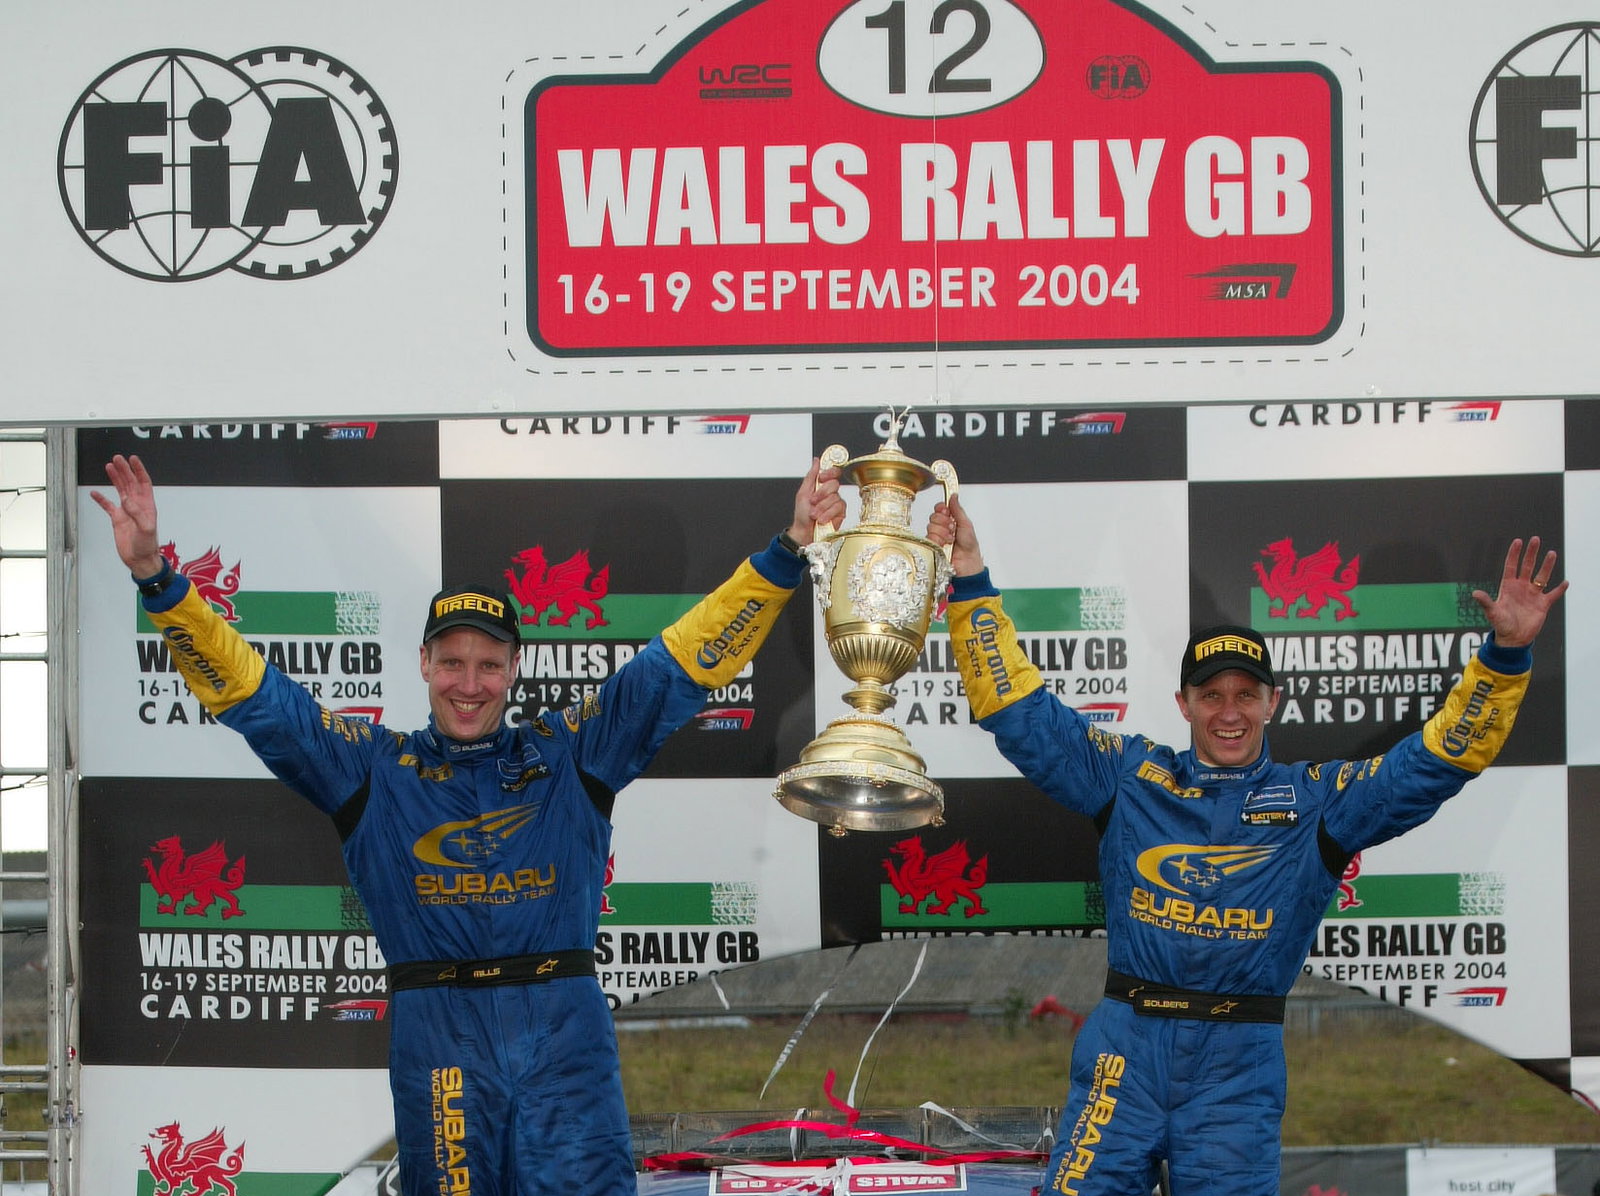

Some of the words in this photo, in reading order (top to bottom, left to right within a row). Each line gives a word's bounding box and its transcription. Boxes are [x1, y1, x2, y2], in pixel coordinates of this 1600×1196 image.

[865, 0, 992, 94] 12
[699, 63, 792, 84] WRC
[556, 142, 870, 248] WALES
[900, 138, 1166, 242] RALLY
[1184, 136, 1311, 239] GB
[557, 271, 690, 315] 16-19
[711, 267, 996, 312] SEPTEMBER
[1017, 263, 1140, 307] 2004
[1225, 282, 1269, 299] MSA
[500, 416, 681, 435] CARDIFF
[873, 411, 1057, 438] CARDIFF
[1250, 401, 1433, 427] CARDIFF
[131, 422, 310, 440] CARDIFF
[435, 593, 504, 618] PIRELLI
[697, 599, 765, 670] Corona
[729, 625, 760, 657] Extra
[1195, 634, 1263, 663] PIRELLI
[341, 641, 383, 674] GB
[966, 638, 983, 679] Extra
[970, 607, 1013, 697] Corona
[1084, 637, 1128, 671] GB
[1364, 633, 1455, 670] RALLY
[332, 681, 383, 698] 2004
[888, 680, 934, 698] 6-19
[1075, 677, 1128, 695] 2004
[1318, 673, 1443, 695] SEPTEMBER
[713, 719, 740, 730] MSA
[1281, 696, 1436, 725] ARDIFF
[1443, 679, 1496, 758] Corona
[1473, 707, 1500, 741] Extra
[414, 864, 556, 896] SUBARU
[417, 894, 468, 906] WORLD
[472, 893, 517, 905] RALLY
[523, 886, 556, 901] TEAM
[1130, 886, 1274, 931] SUBARU
[1128, 909, 1172, 931] WORLD
[1176, 923, 1223, 940] RALLY
[1228, 930, 1269, 941] TEAM
[1368, 923, 1457, 957] RALLY
[1464, 922, 1507, 956] GB
[138, 932, 244, 969] WALES
[249, 934, 339, 970] RALLY
[621, 931, 710, 965] RALLY
[716, 930, 760, 963] GB
[140, 972, 198, 992] 16-19
[205, 973, 327, 993] SEPTEMBER
[335, 975, 388, 994] 2004
[597, 970, 698, 988] PTEMBER
[1322, 962, 1445, 981] SEPTEMBER
[1454, 961, 1507, 979] 2004
[140, 994, 320, 1021] CARDIFF
[346, 1011, 373, 1020] MSA
[1143, 998, 1189, 1010] SOLBERG
[1088, 1053, 1108, 1101] WORLD
[431, 1068, 442, 1122] WORLD
[1070, 1104, 1094, 1147] RALLY
[433, 1125, 446, 1171] RALLY
[856, 1176, 947, 1187] WALES
[1052, 1150, 1073, 1190] TEAM
